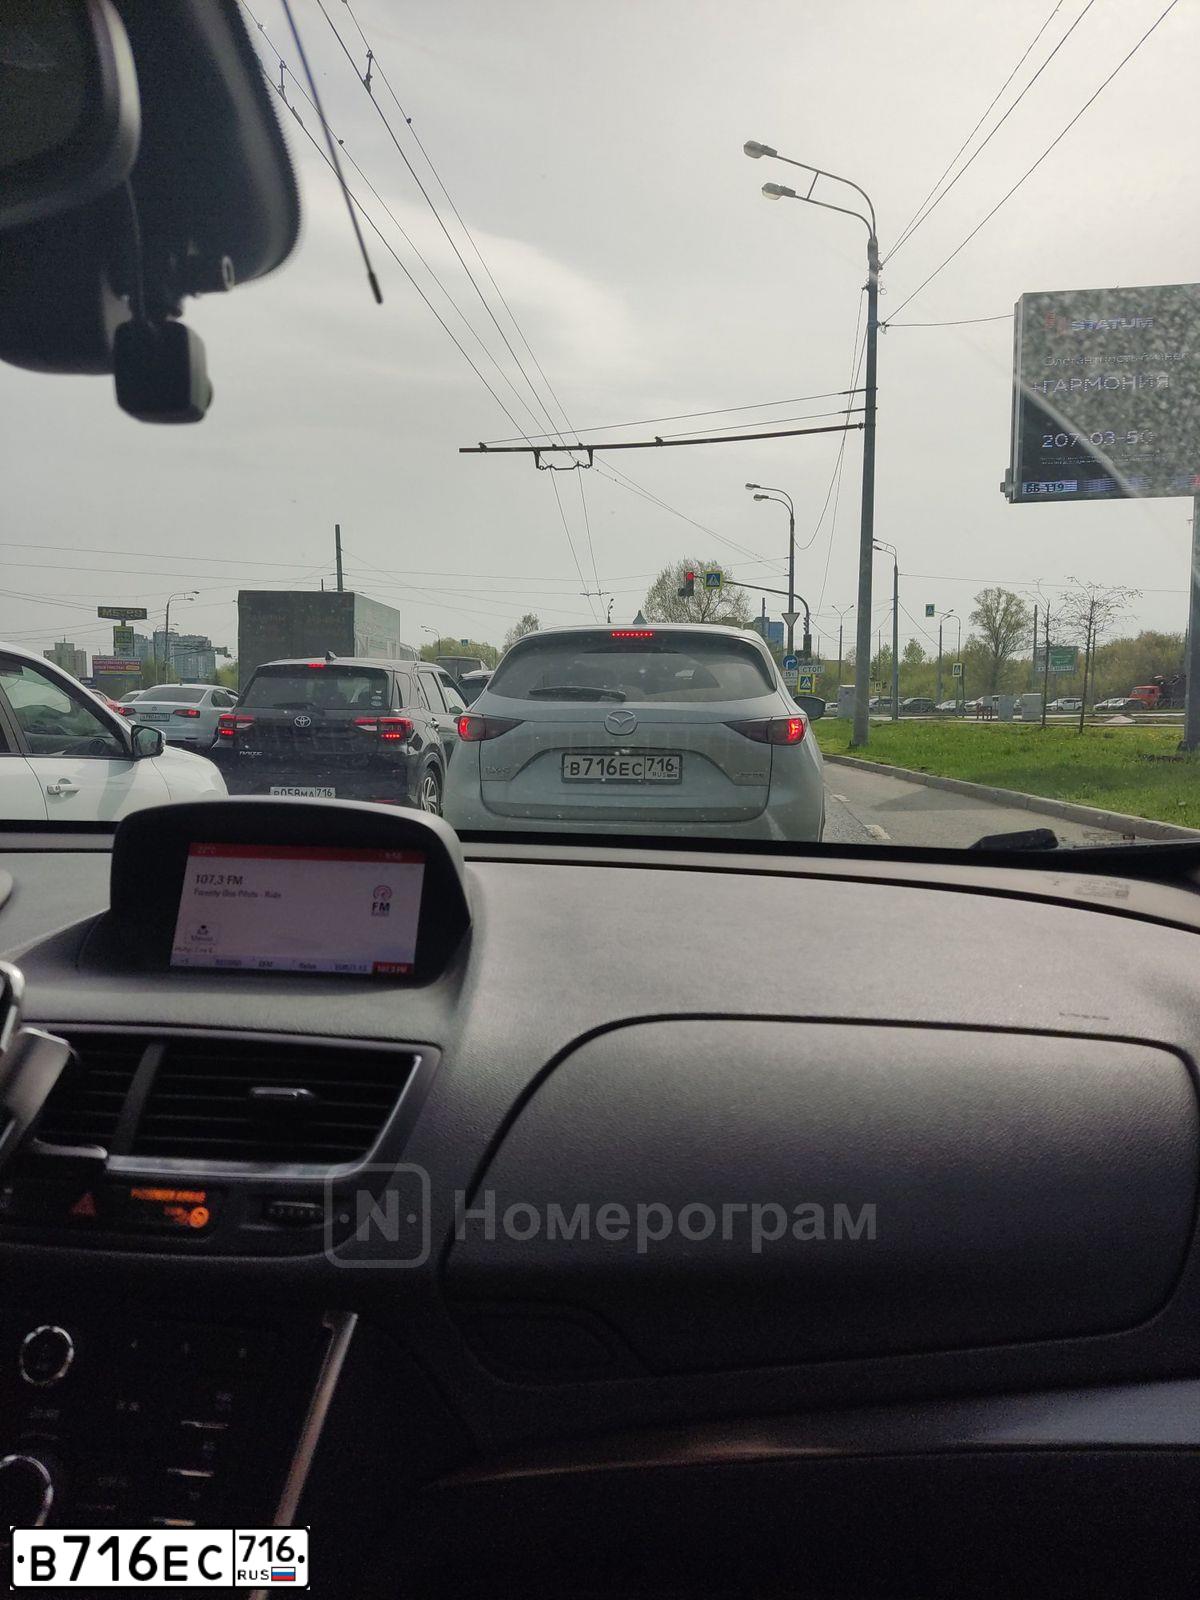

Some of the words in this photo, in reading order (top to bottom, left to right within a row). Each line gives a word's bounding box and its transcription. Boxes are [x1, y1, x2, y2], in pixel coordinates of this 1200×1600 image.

[570, 758, 642, 776] В716ЕС
[646, 758, 674, 772] 716
[316, 788, 332, 797] 716
[226, 874, 243, 886] FM
[372, 902, 390, 911] FM
